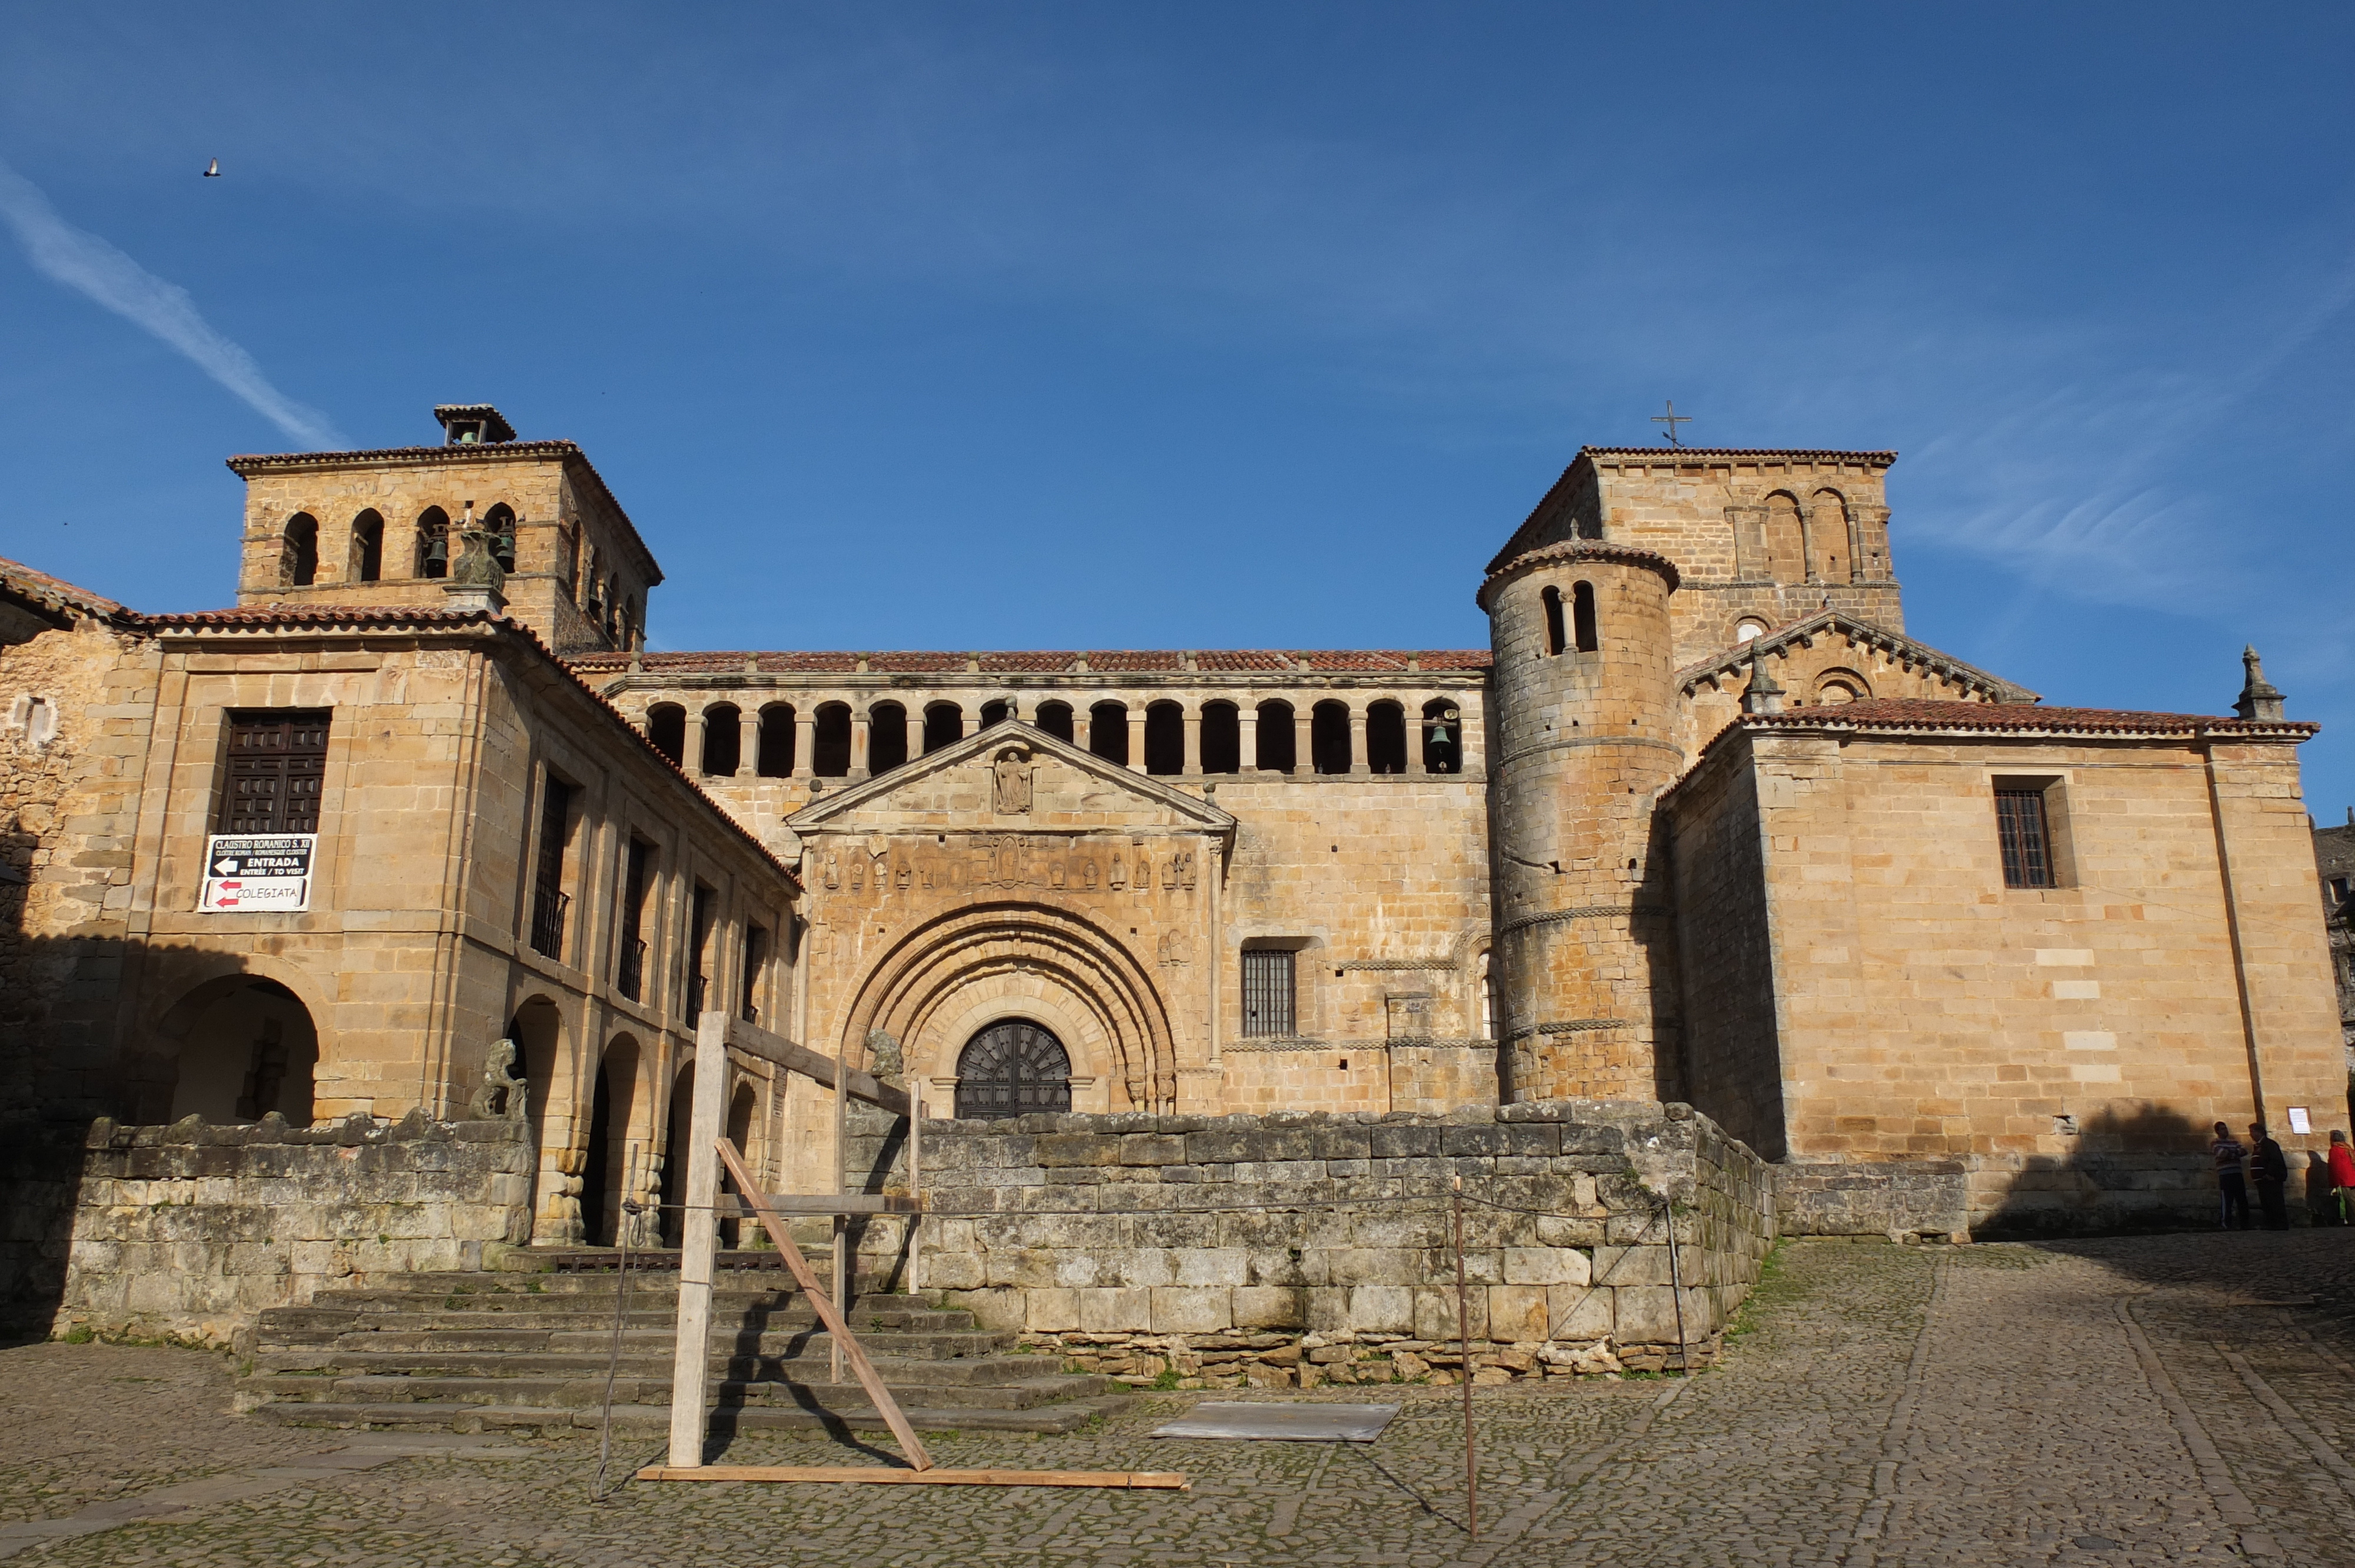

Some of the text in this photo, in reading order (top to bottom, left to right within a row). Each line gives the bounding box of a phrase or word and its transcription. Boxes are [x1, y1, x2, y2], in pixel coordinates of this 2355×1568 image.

[292, 839, 299, 848] S.
[247, 858, 299, 867] ENTRADA
[237, 888, 297, 898] COLEGIATA
